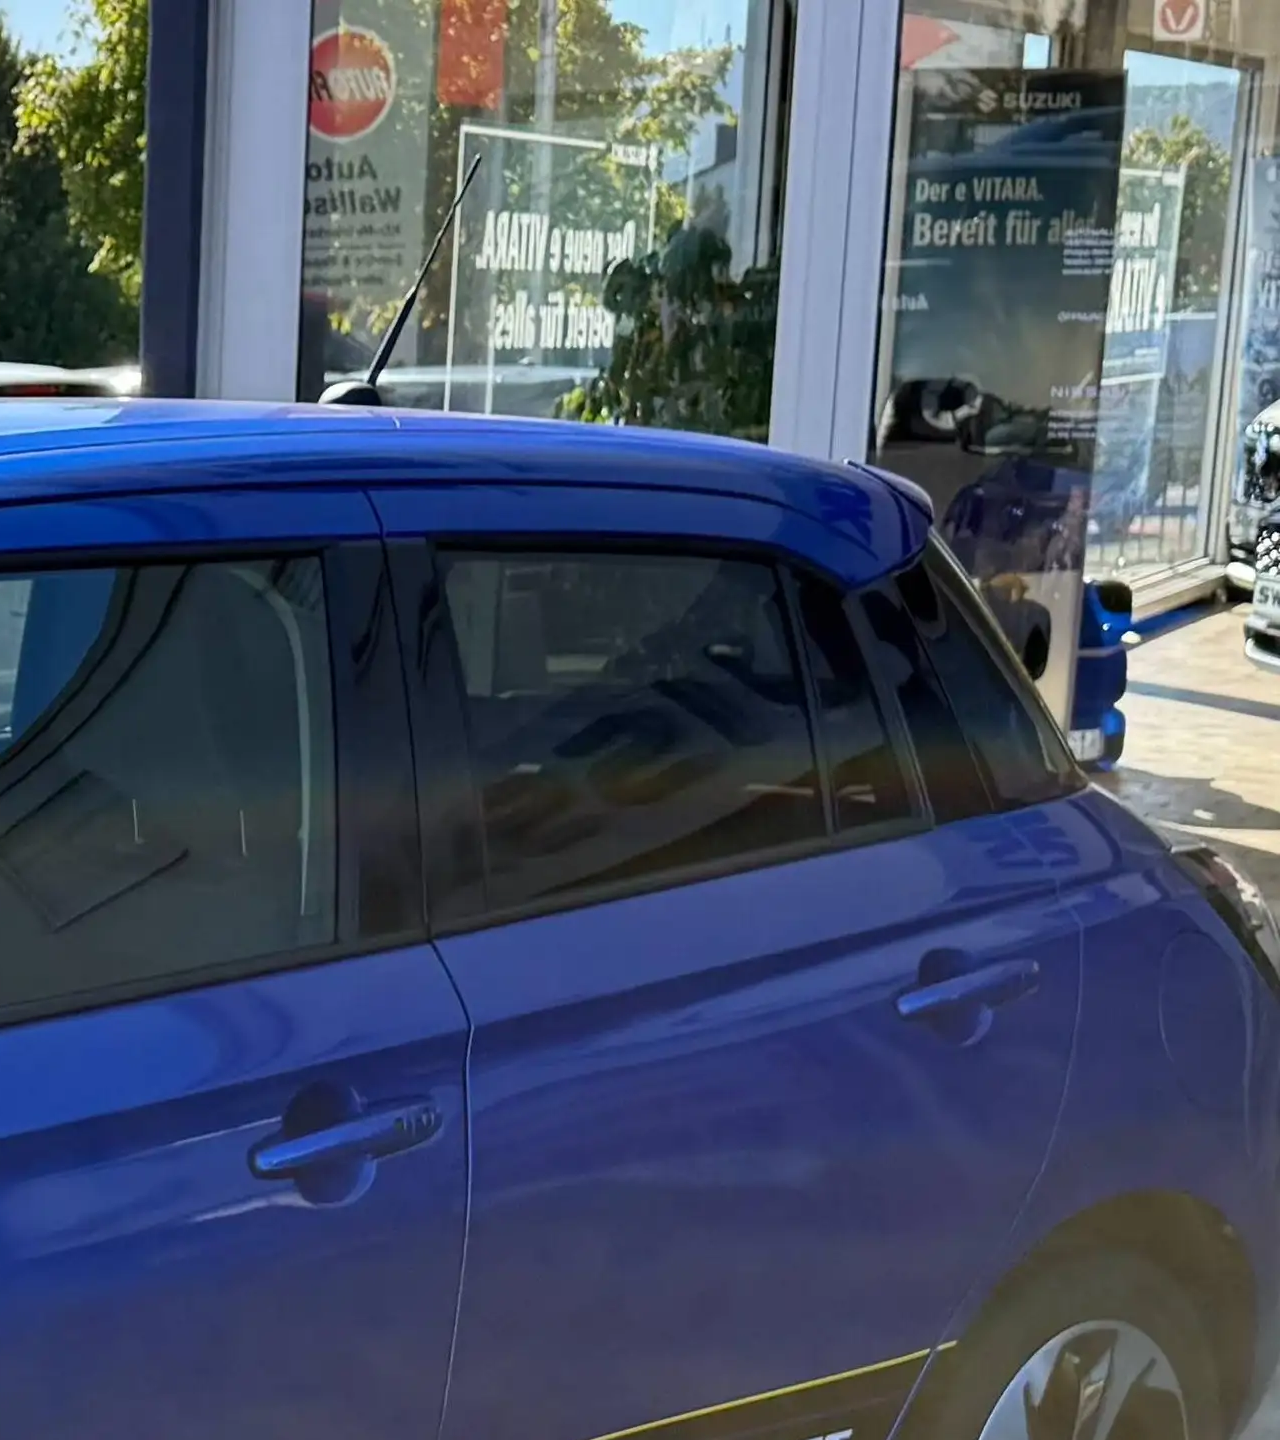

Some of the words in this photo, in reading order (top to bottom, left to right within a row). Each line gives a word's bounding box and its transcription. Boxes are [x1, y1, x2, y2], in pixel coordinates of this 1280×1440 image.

[1003, 91, 1081, 109] SUZUKI
[915, 178, 951, 202] Der
[955, 181, 967, 201] e
[973, 176, 1044, 201] VITARA.
[912, 210, 998, 248] Bereit
[1005, 209, 1044, 246] für
